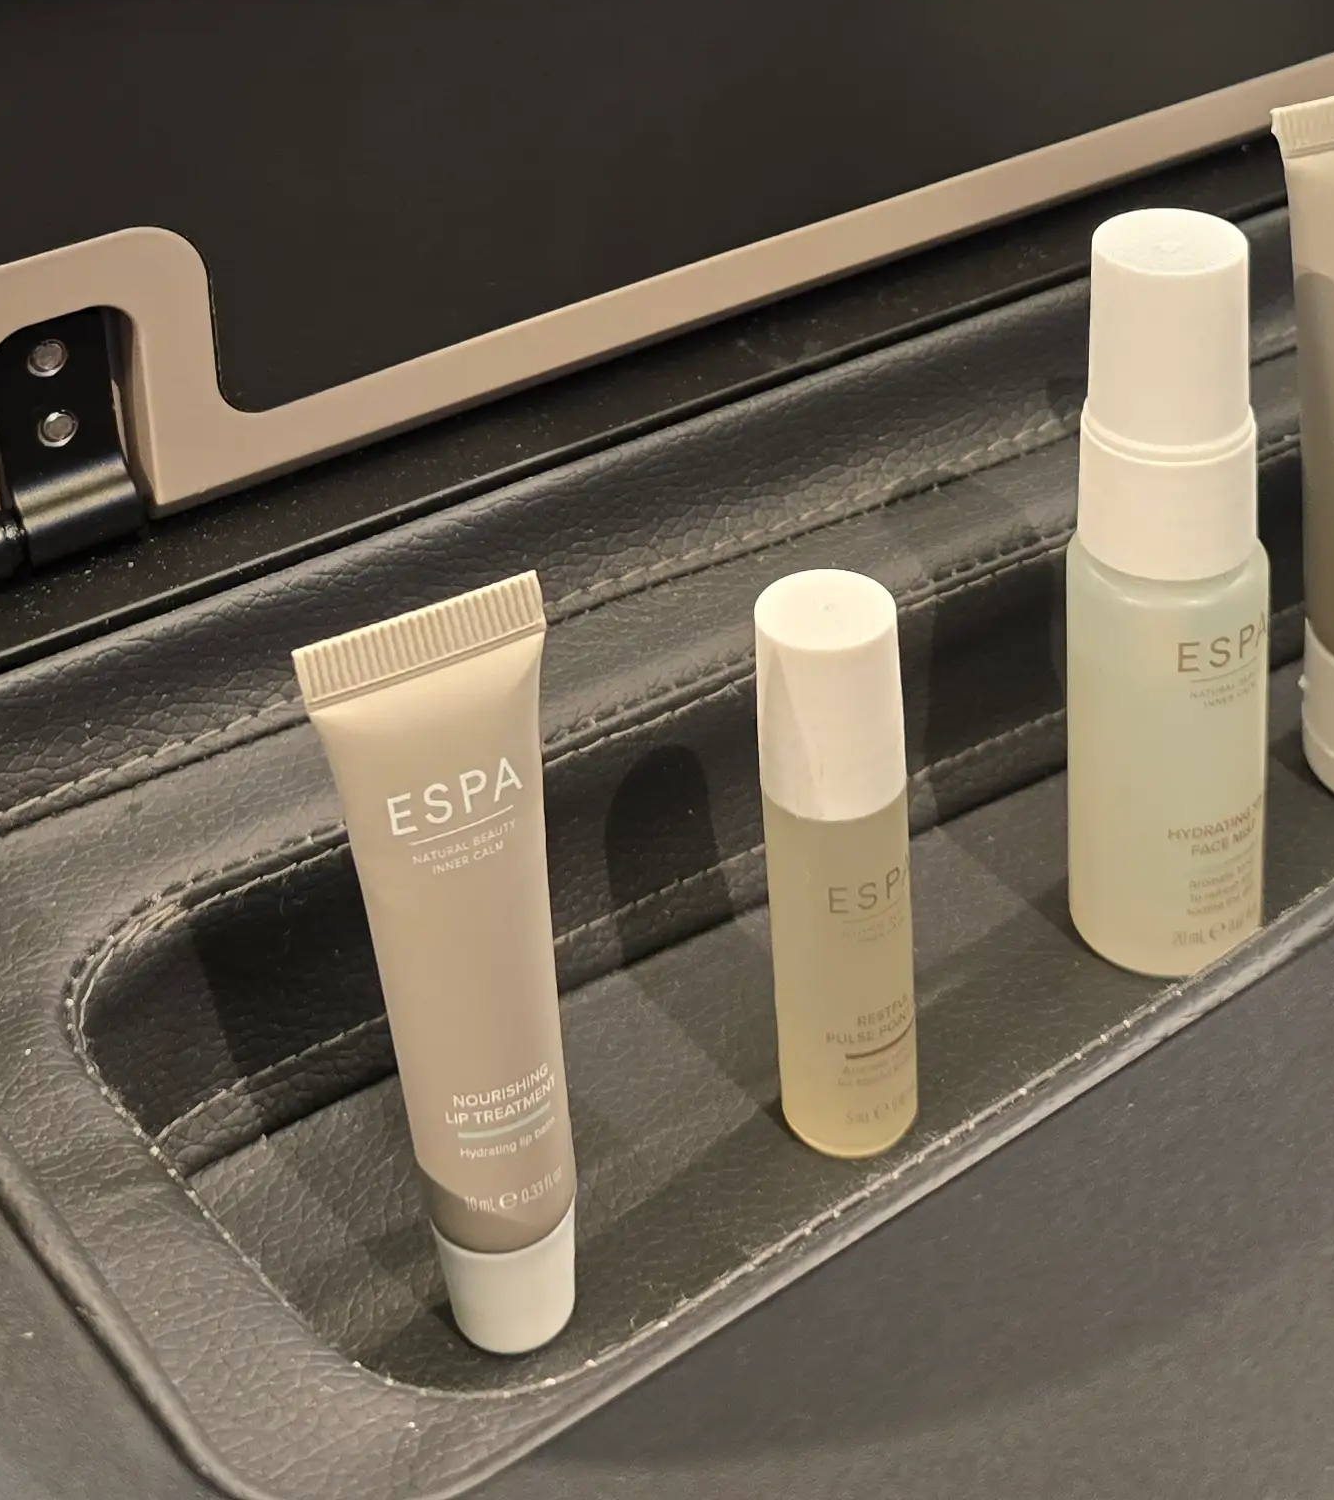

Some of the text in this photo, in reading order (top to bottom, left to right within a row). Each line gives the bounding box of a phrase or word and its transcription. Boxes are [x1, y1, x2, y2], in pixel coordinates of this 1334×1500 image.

[387, 757, 523, 836] ESPA
[412, 818, 516, 865] NATURAL BEAUTY
[432, 840, 505, 875] INNER CALM
[445, 1072, 556, 1125] LIP TREATMENT
[453, 1062, 549, 1108] NOURISHING
[460, 1141, 517, 1159] Hydrating
[519, 1132, 533, 1145] lip
